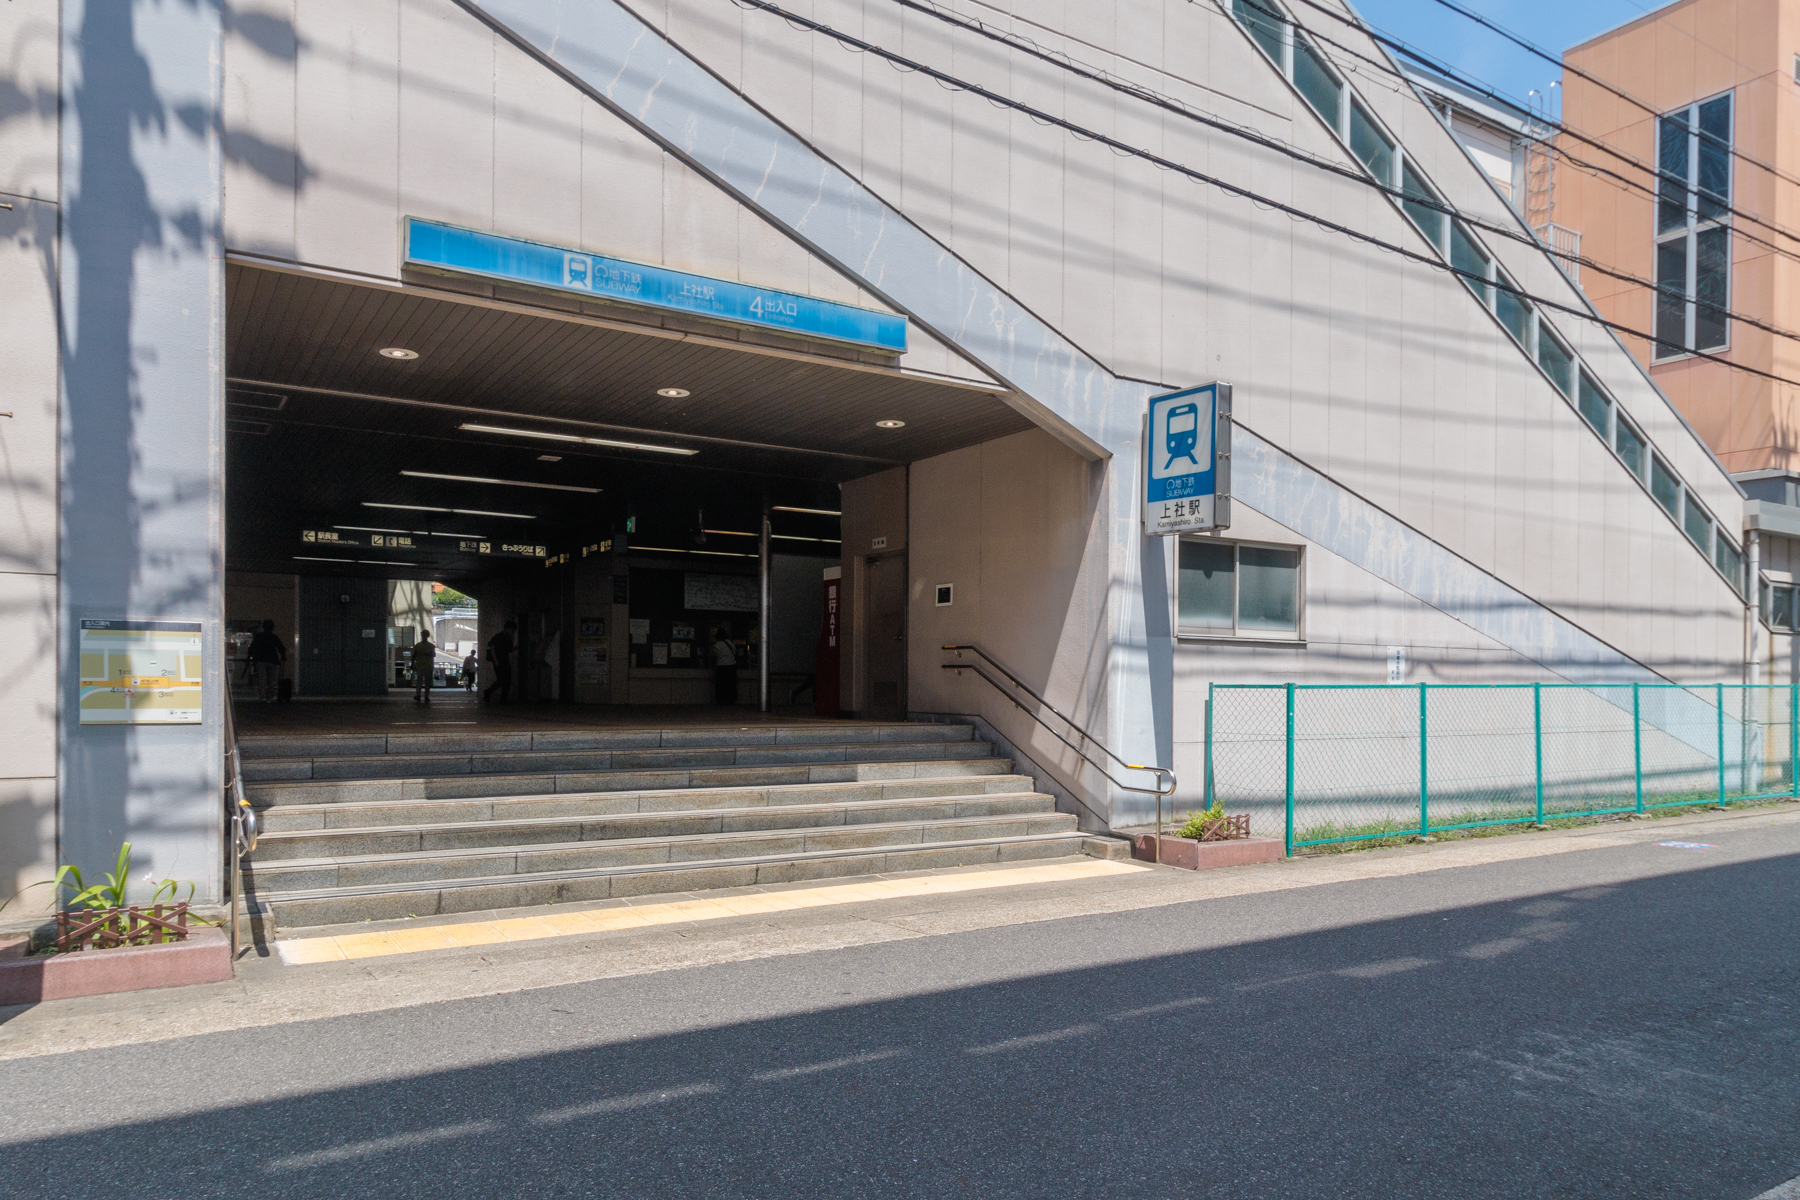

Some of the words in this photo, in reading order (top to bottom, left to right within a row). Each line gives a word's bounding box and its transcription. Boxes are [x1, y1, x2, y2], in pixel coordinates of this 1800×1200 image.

[609, 268, 642, 284] 地下鉄
[595, 278, 641, 294] SUBWAY
[680, 282, 715, 300] 上社駅
[749, 296, 764, 318] 4
[765, 299, 797, 316] 出入口
[765, 312, 795, 323] Entrance
[1175, 477, 1195, 488] 地下鉄
[1166, 487, 1194, 497] SUBWAY
[1160, 499, 1200, 519] 上社駅
[1157, 519, 1192, 528] Kamiyashiro
[502, 543, 534, 552] きっぷうりば
[828, 586, 837, 647] 銀行ATM
